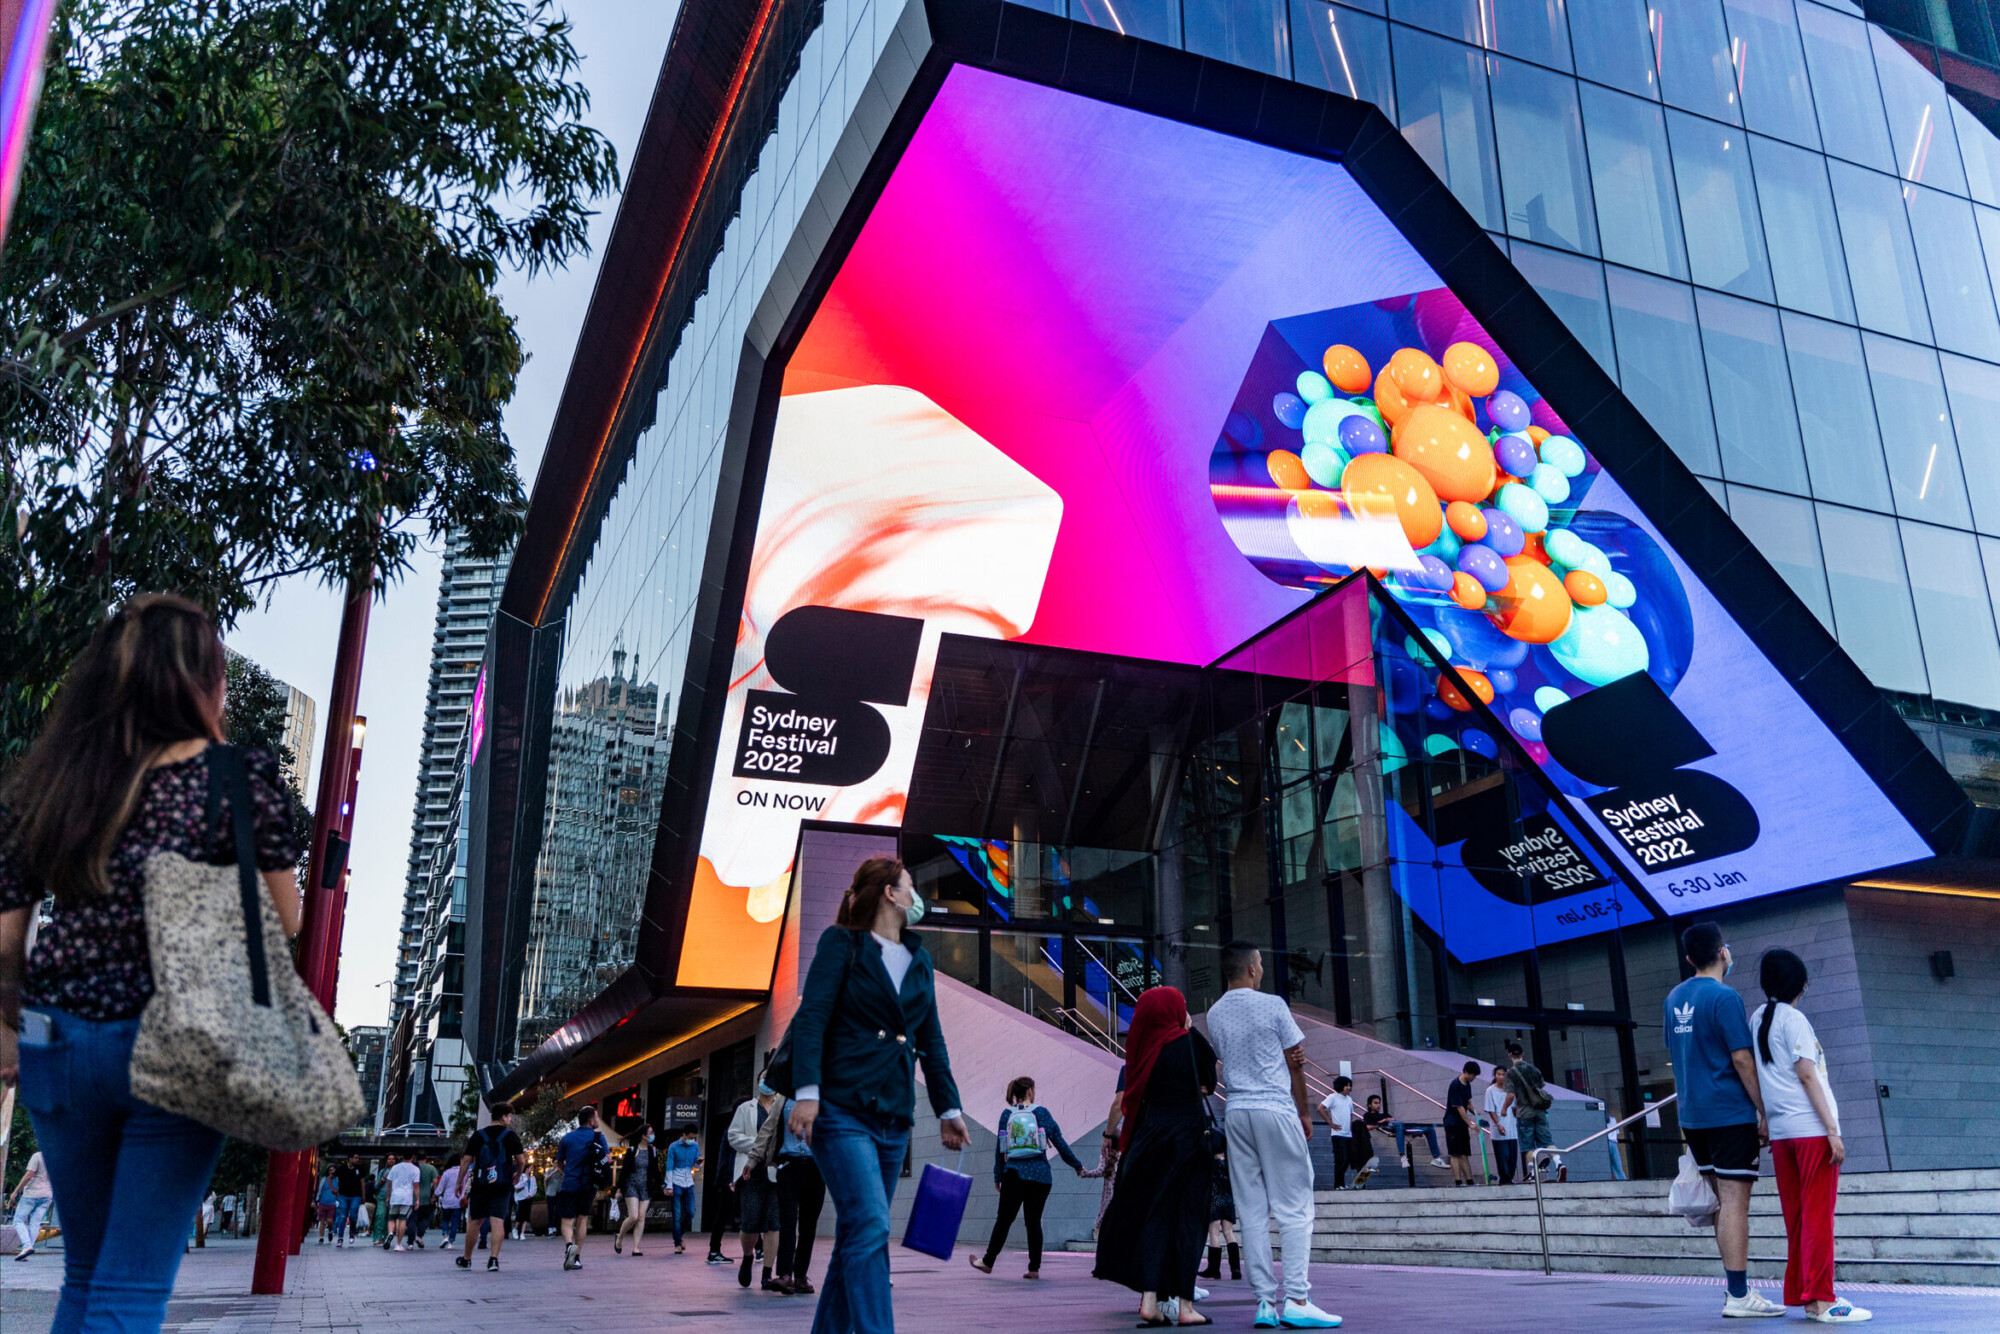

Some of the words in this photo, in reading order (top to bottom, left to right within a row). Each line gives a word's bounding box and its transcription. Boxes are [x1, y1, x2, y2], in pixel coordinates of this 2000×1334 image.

[751, 705, 837, 737] Sydney
[747, 728, 838, 755] Festival
[743, 751, 803, 774] 2022
[736, 790, 768, 807] ON
[772, 793, 826, 812] NOW
[1602, 793, 1681, 828] Sydney
[1618, 808, 1705, 847] Festival
[1636, 837, 1695, 866] 2022
[1667, 876, 1712, 897] 6-30
[1713, 871, 1748, 888] Jan
[676, 1103, 698, 1111] CLOAK
